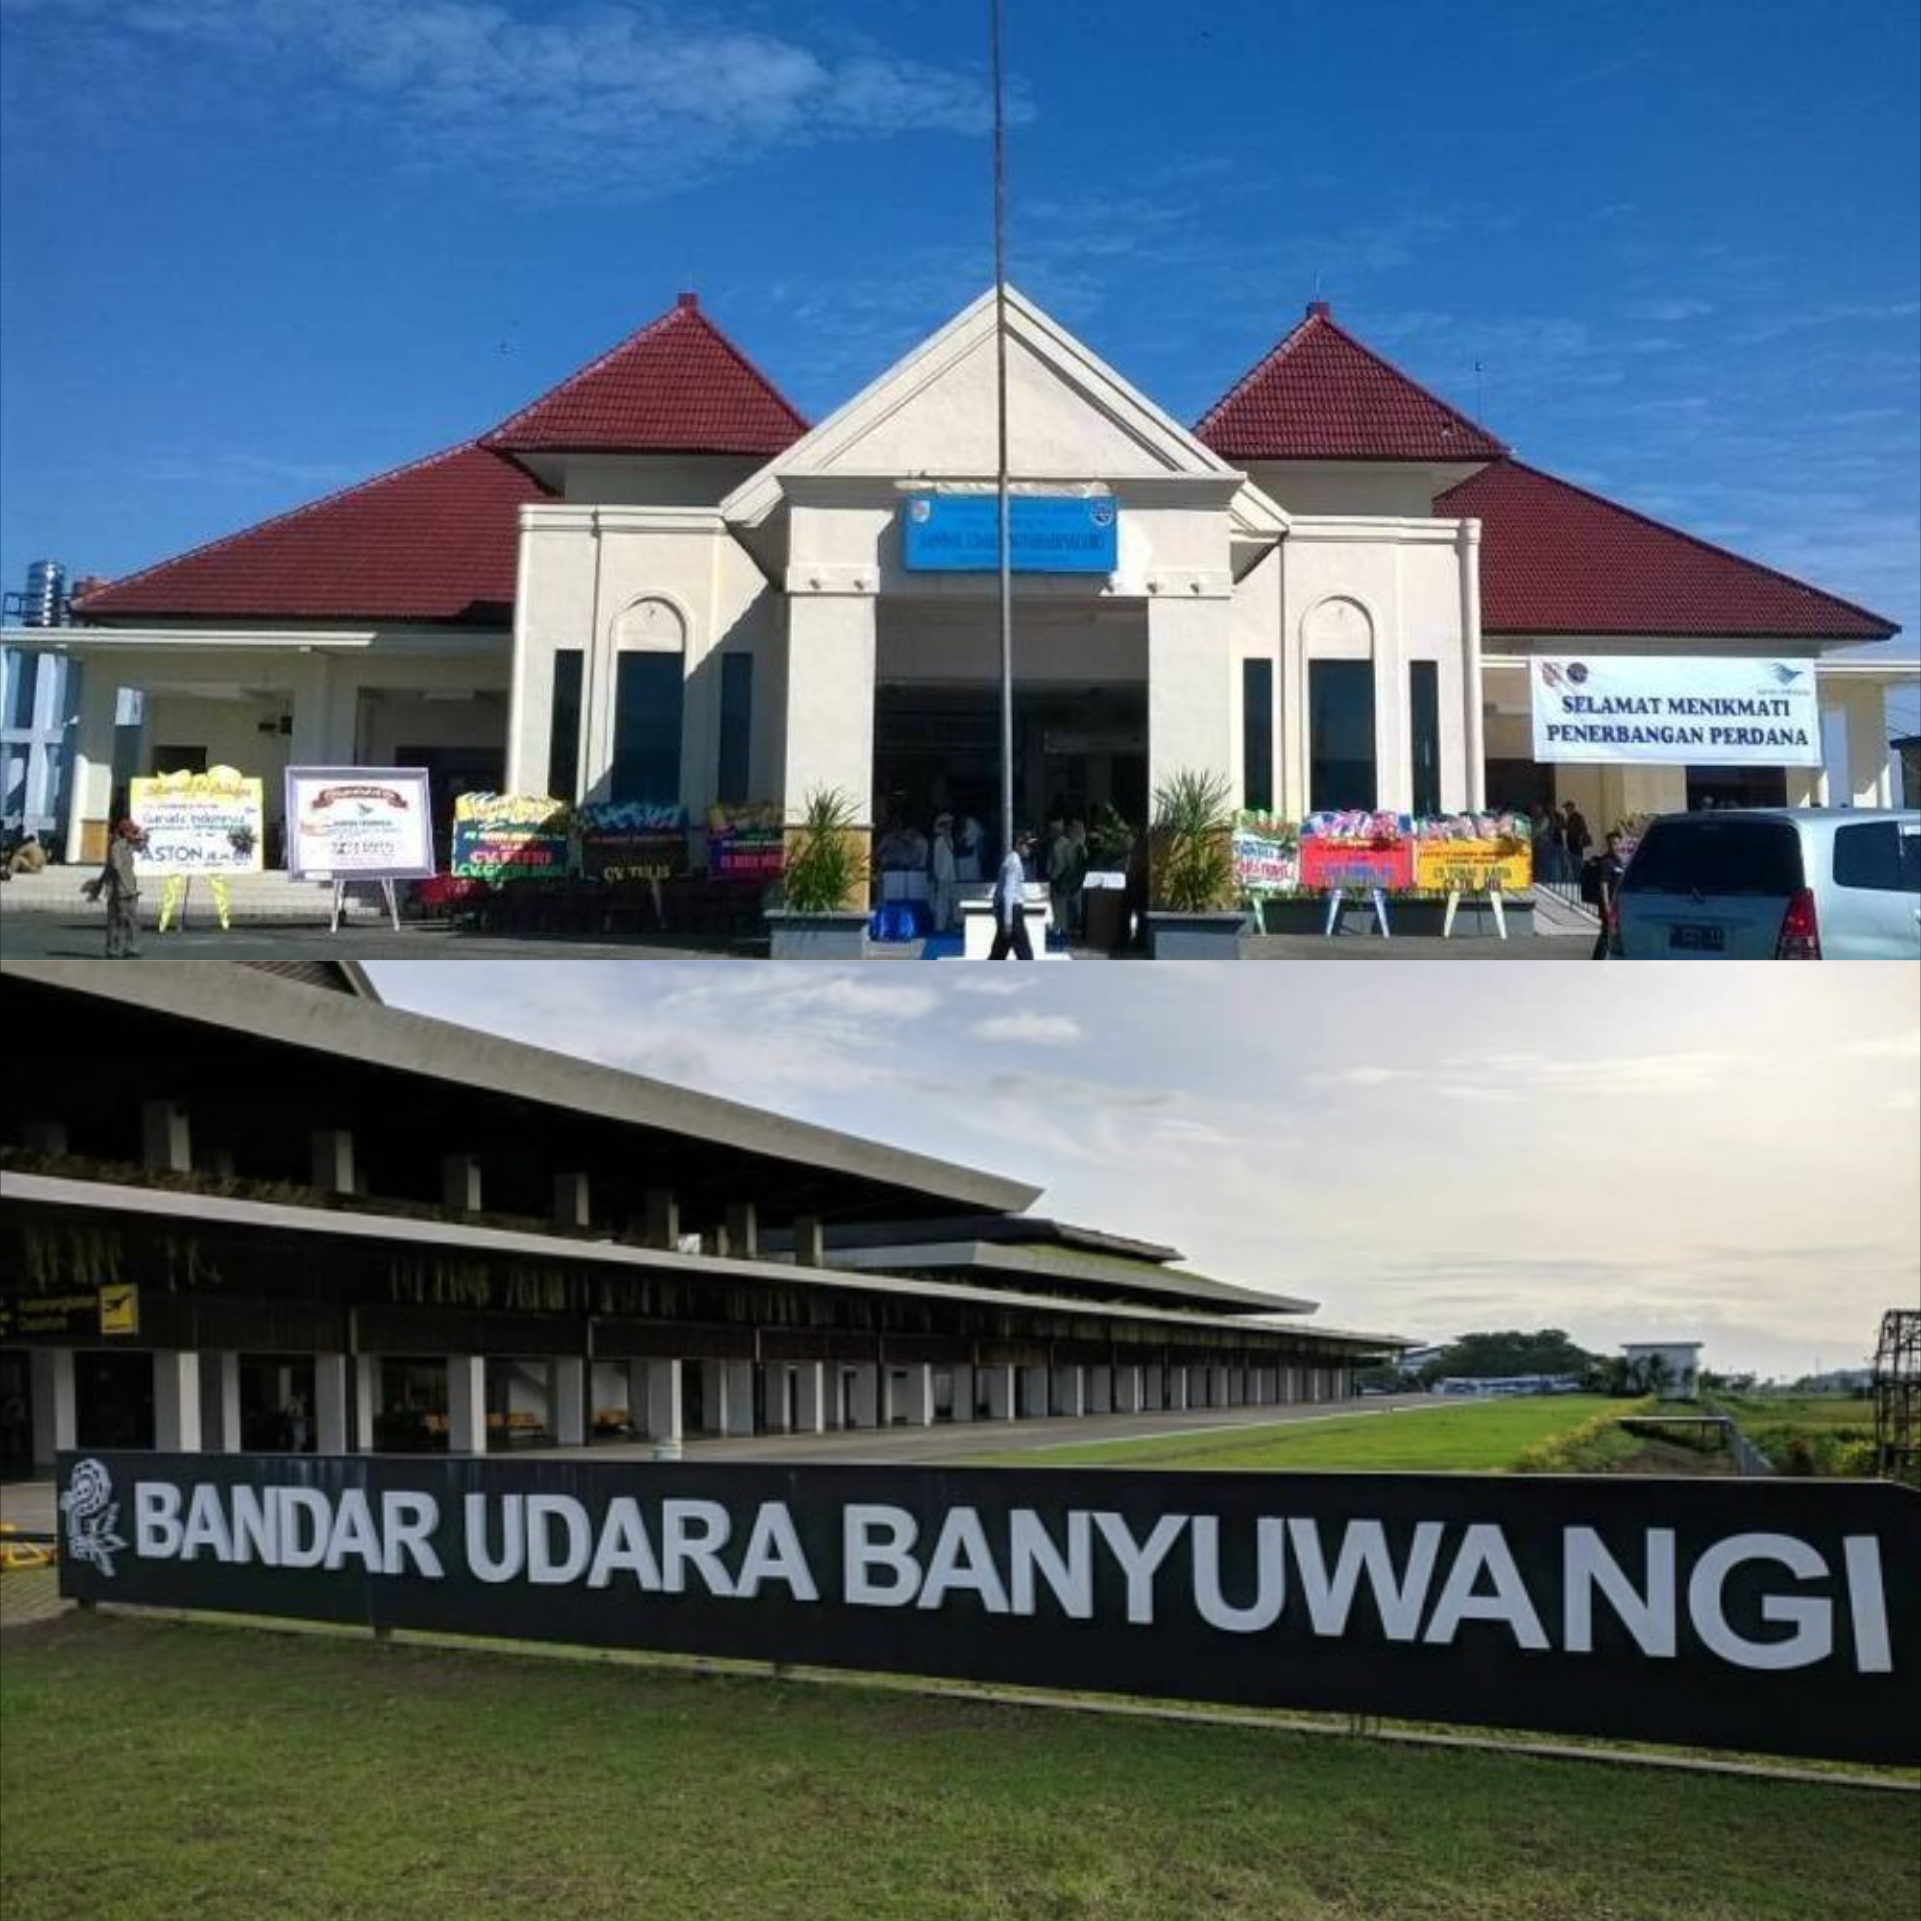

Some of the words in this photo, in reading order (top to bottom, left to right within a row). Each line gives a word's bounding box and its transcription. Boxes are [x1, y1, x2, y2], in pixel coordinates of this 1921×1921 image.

[1562, 696, 1661, 714] SELAMAT
[1667, 697, 1790, 717] MENIKMATI
[1547, 725, 1704, 744] PENERBANGAN
[1710, 727, 1808, 746] PERDANA
[141, 845, 203, 861] ASTON
[136, 1482, 443, 1576] BANDAR
[466, 1494, 817, 1600] UDARA
[845, 1505, 1891, 1671] BANYUWANGI
